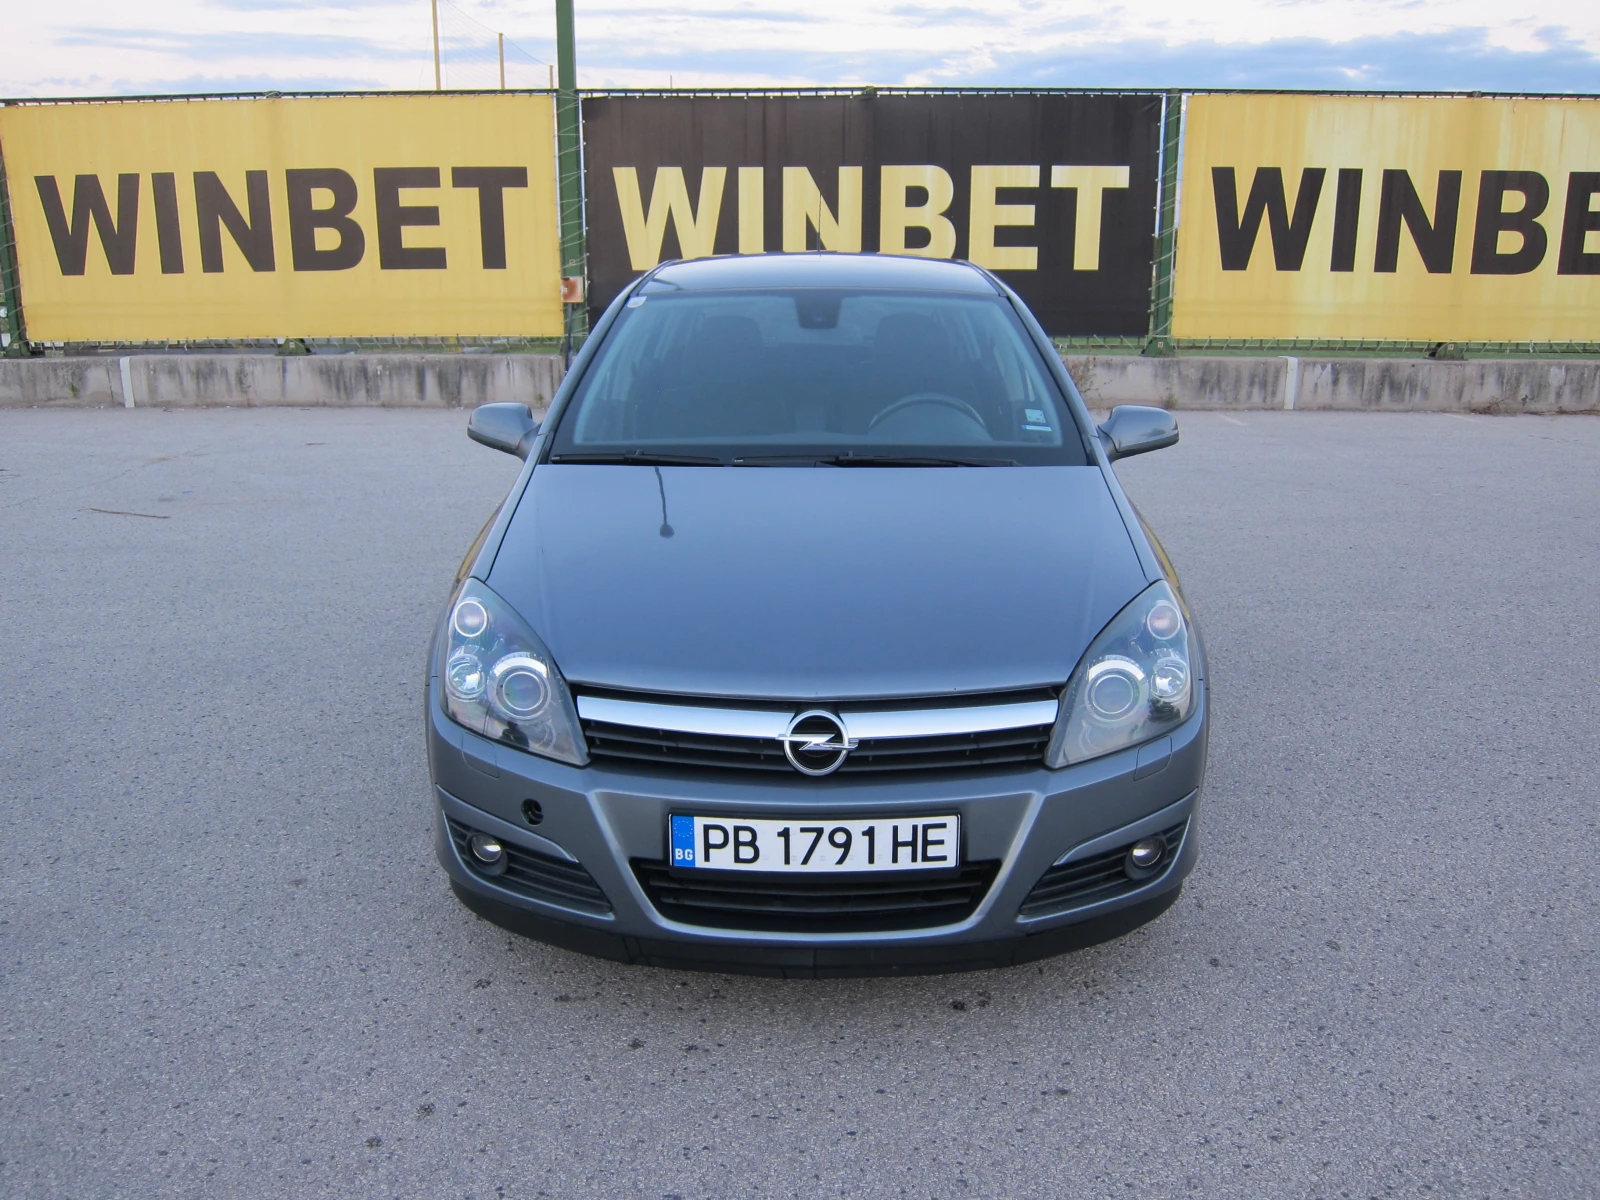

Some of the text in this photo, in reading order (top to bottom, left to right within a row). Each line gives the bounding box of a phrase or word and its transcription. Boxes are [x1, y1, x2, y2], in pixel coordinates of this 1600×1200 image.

[33, 166, 528, 276] WINBET
[612, 164, 1130, 270] WINBET
[675, 848, 694, 861] BG
[702, 822, 948, 865] PB 1791 HE
